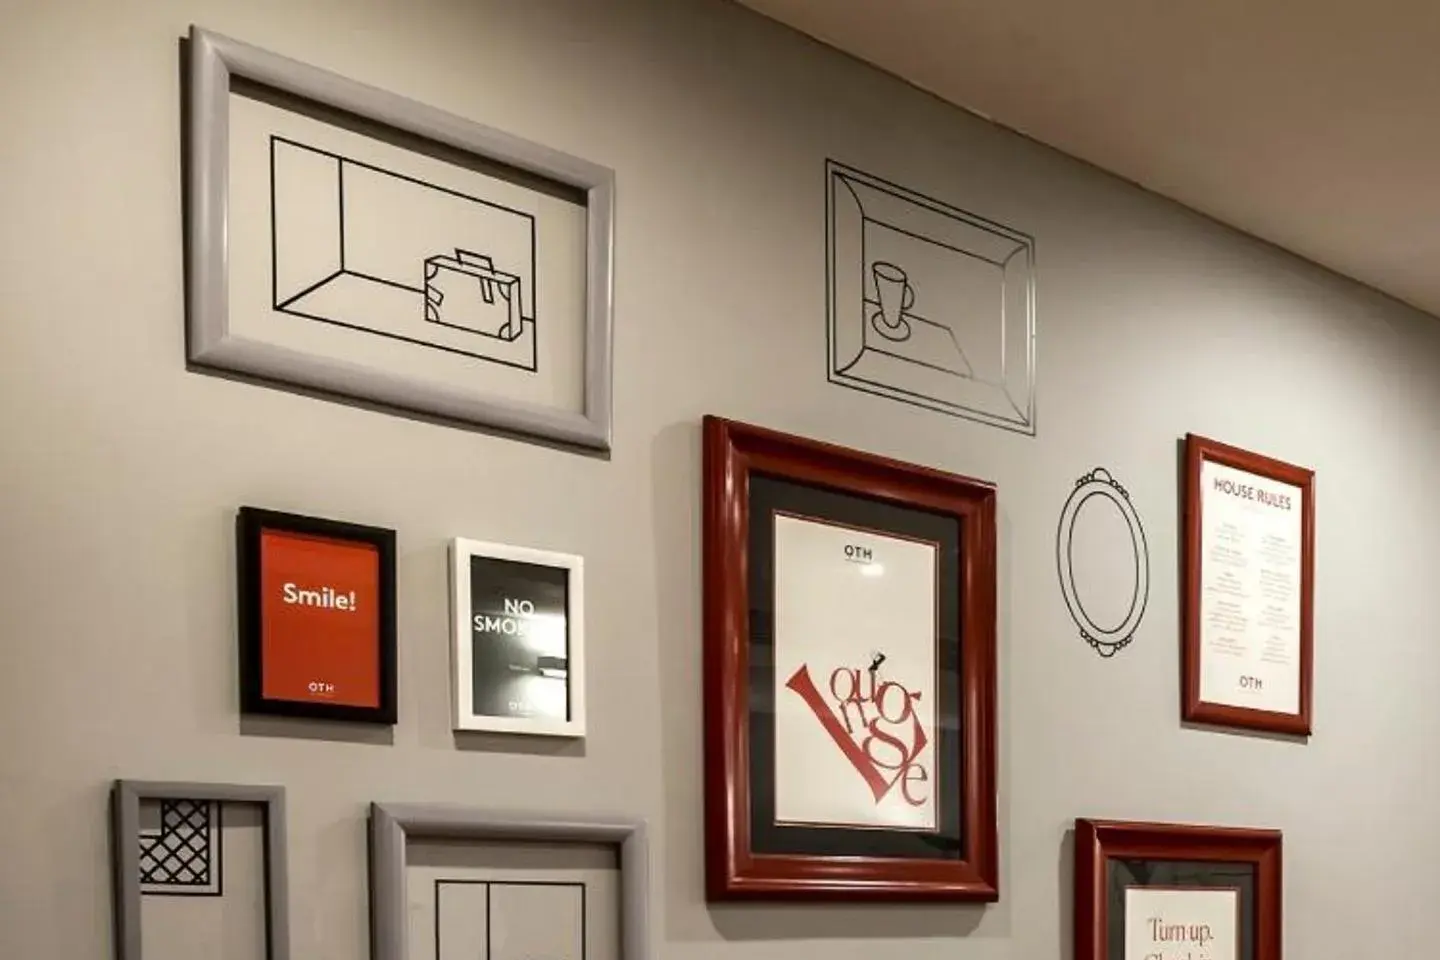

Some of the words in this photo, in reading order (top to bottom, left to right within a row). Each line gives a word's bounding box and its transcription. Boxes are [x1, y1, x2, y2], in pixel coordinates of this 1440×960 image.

[1213, 478, 1254, 501] HOUSE
[1257, 488, 1291, 511] RULES
[844, 544, 873, 561] OTH
[283, 582, 356, 612] Smile!
[504, 598, 534, 617] NO
[308, 682, 334, 693] OTH
[1239, 674, 1263, 690] OTH
[1147, 917, 1186, 942] Turn
